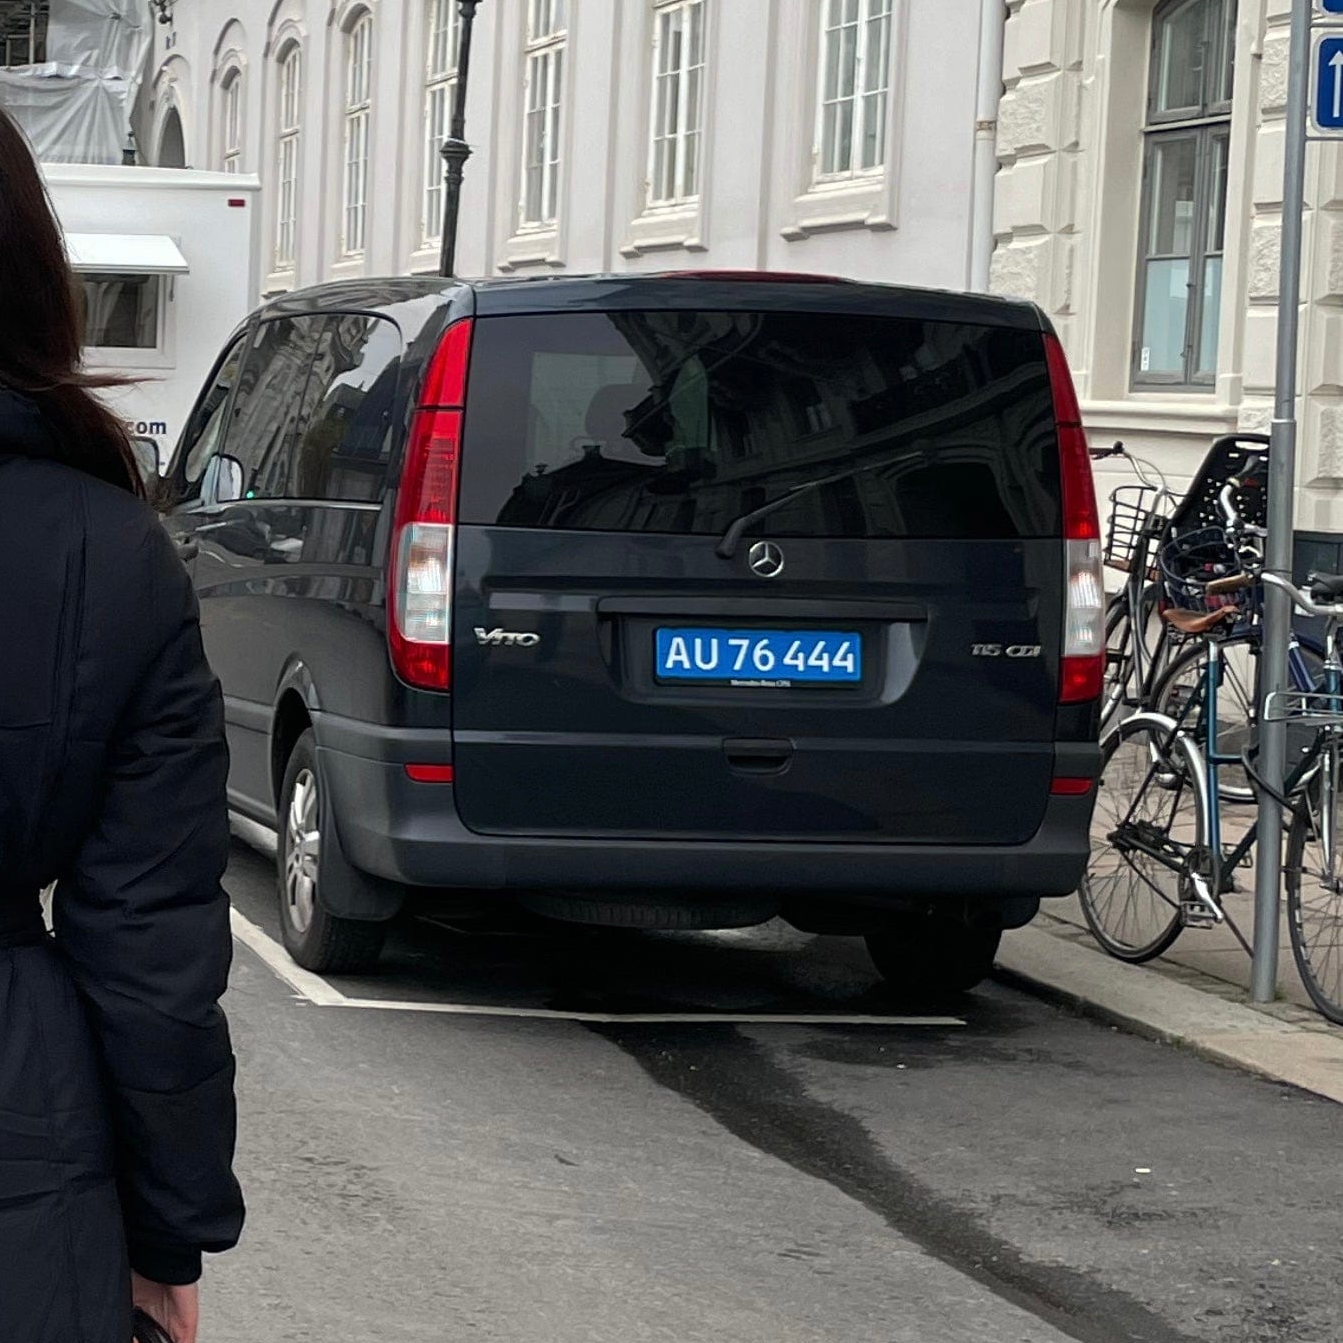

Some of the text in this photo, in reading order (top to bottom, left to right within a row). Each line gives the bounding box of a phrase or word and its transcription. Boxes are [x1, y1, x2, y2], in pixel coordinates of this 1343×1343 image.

[665, 637, 855, 673] AU 76 444
